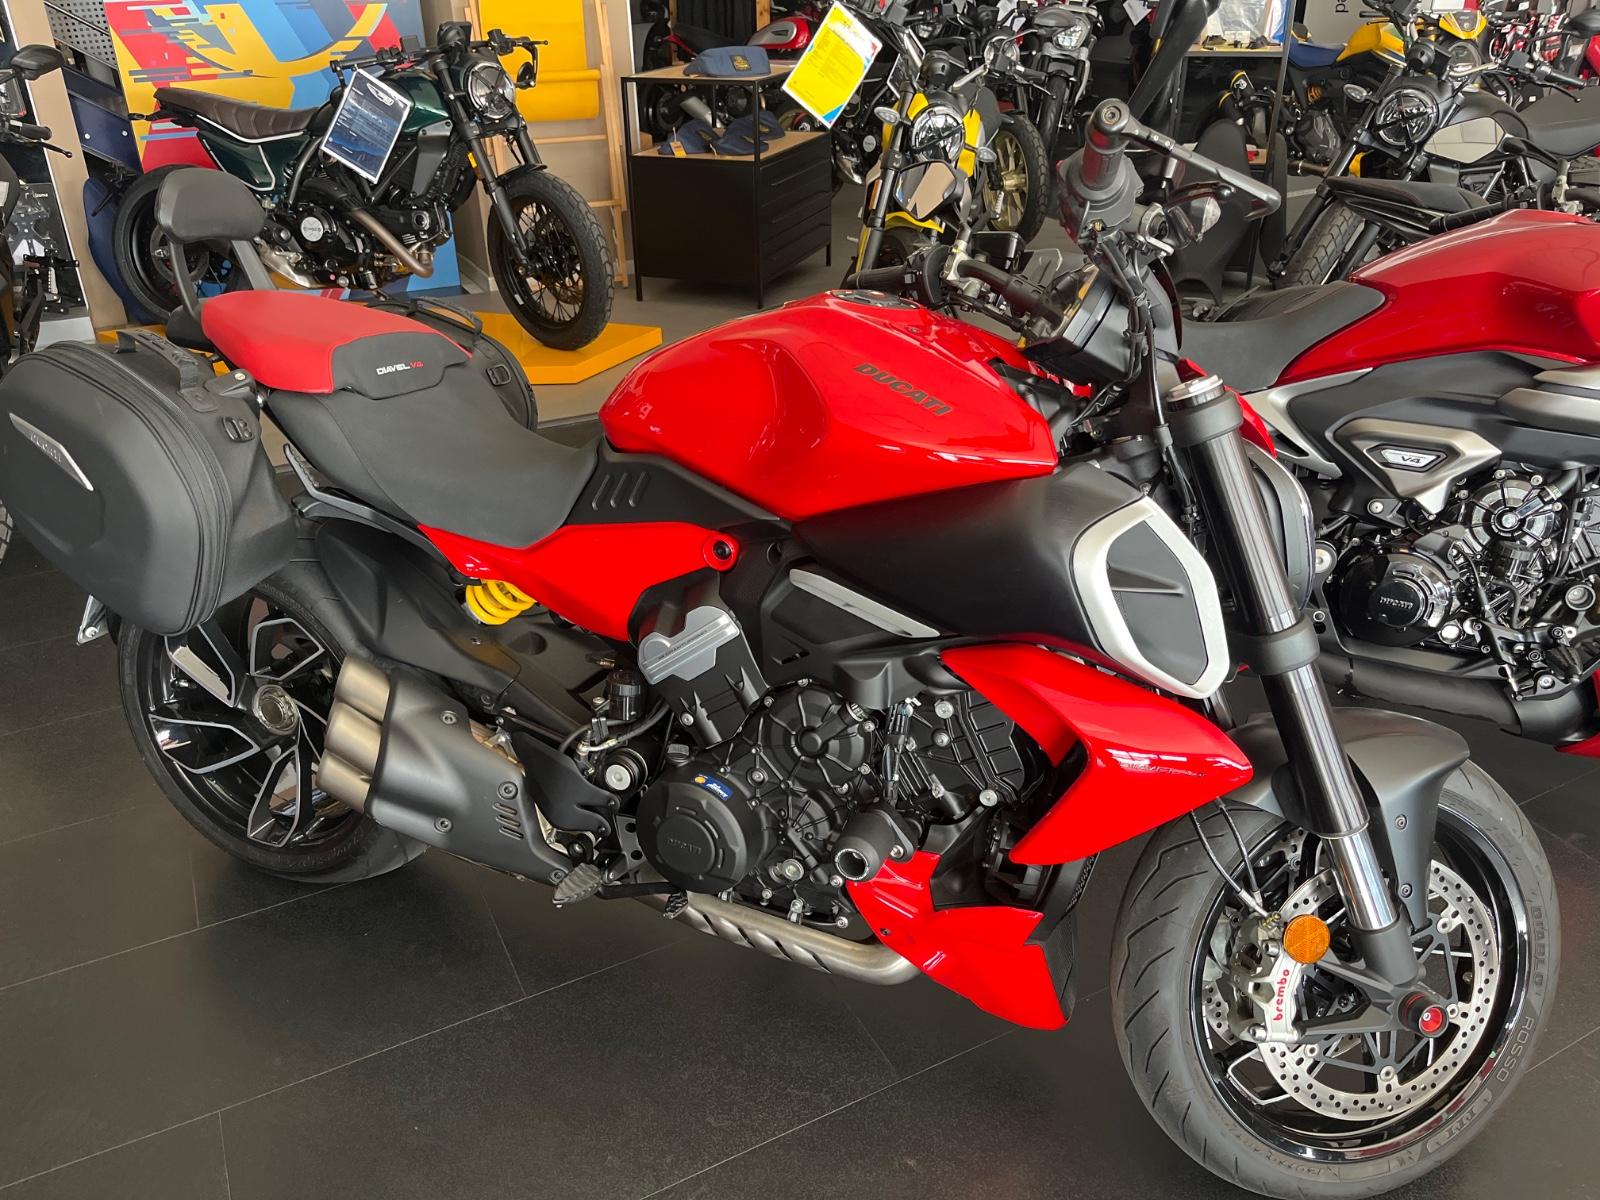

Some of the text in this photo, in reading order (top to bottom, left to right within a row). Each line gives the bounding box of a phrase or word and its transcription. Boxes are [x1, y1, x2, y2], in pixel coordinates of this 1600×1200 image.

[376, 363, 410, 375] DIAVEL
[853, 363, 953, 416] DUCATI
[1401, 455, 1421, 464] V4
[1379, 596, 1414, 610] DUCATI
[1272, 968, 1290, 1021] brembo
[1496, 1016, 1535, 1082] ROSSO
